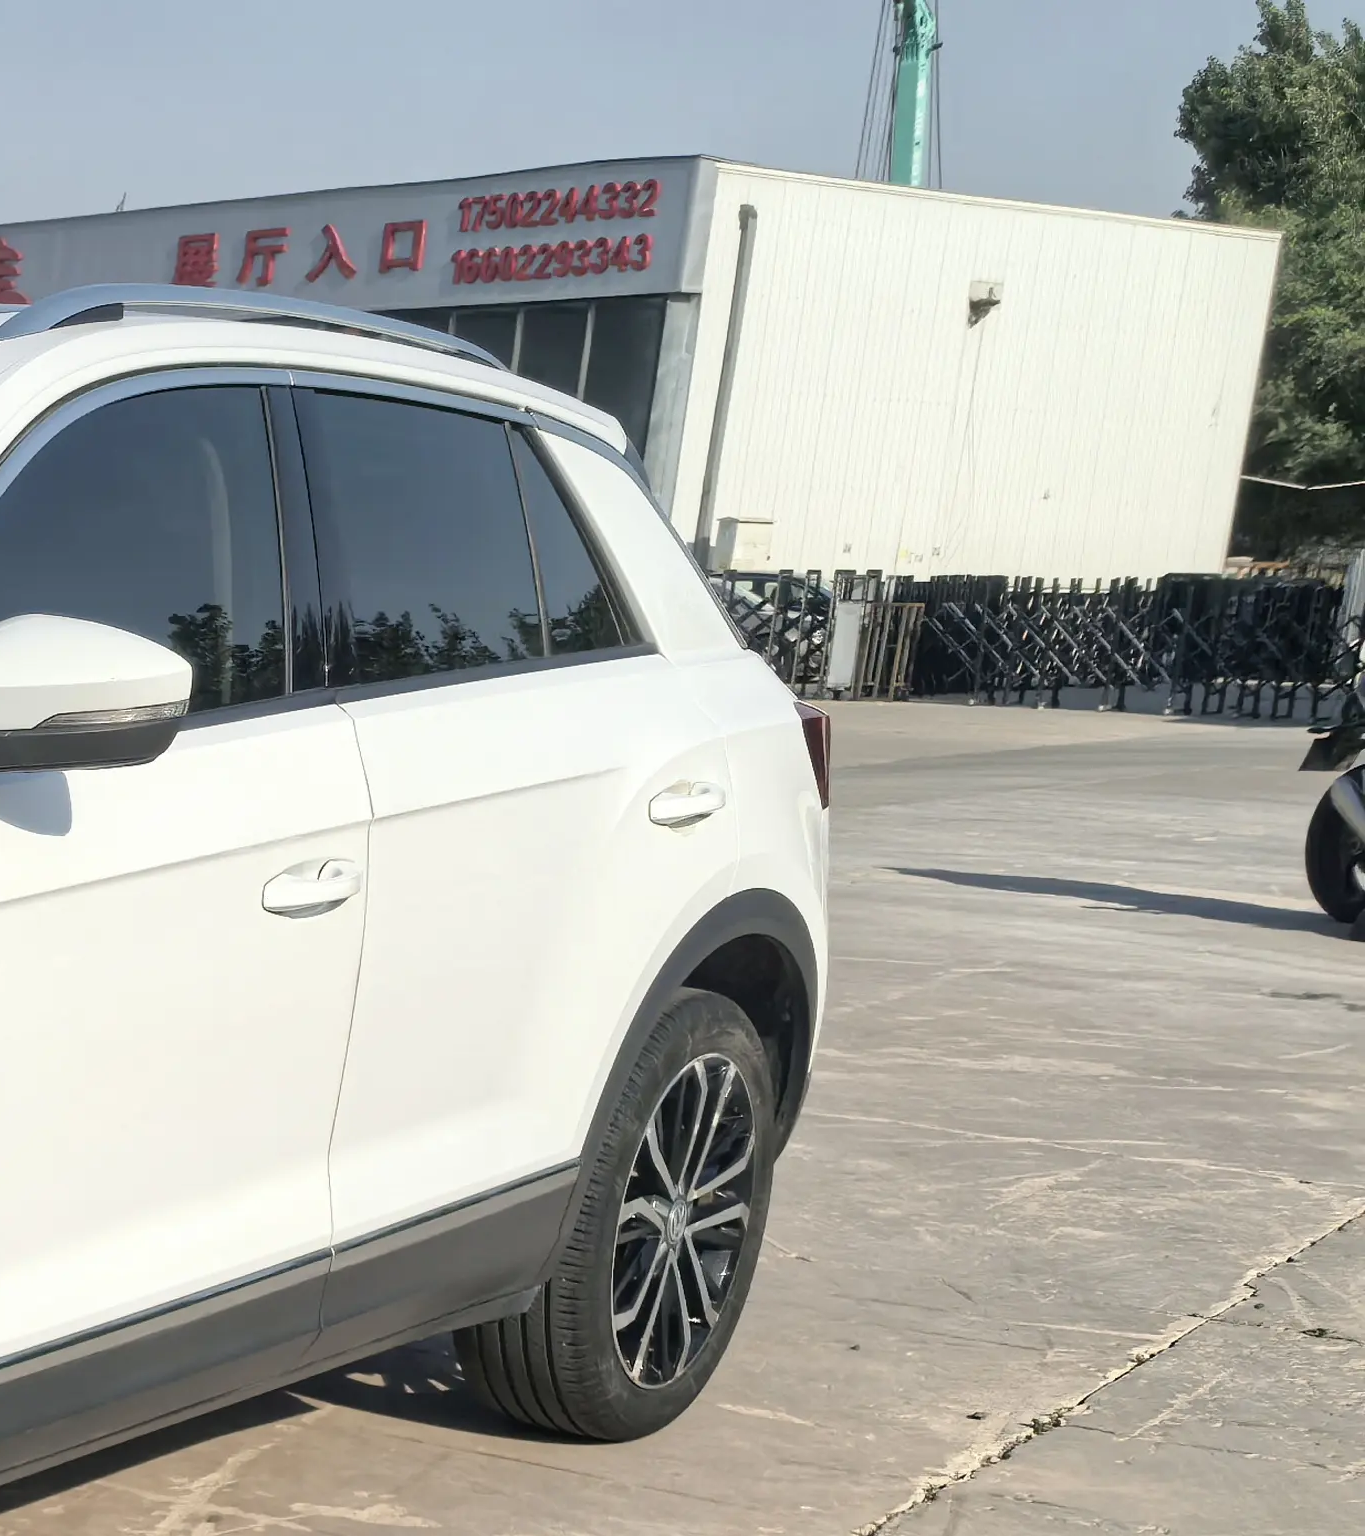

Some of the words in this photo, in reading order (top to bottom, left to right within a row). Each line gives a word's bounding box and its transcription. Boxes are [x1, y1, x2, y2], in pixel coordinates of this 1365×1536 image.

[457, 178, 662, 233] 17502244332
[169, 218, 428, 288] 展厅入口
